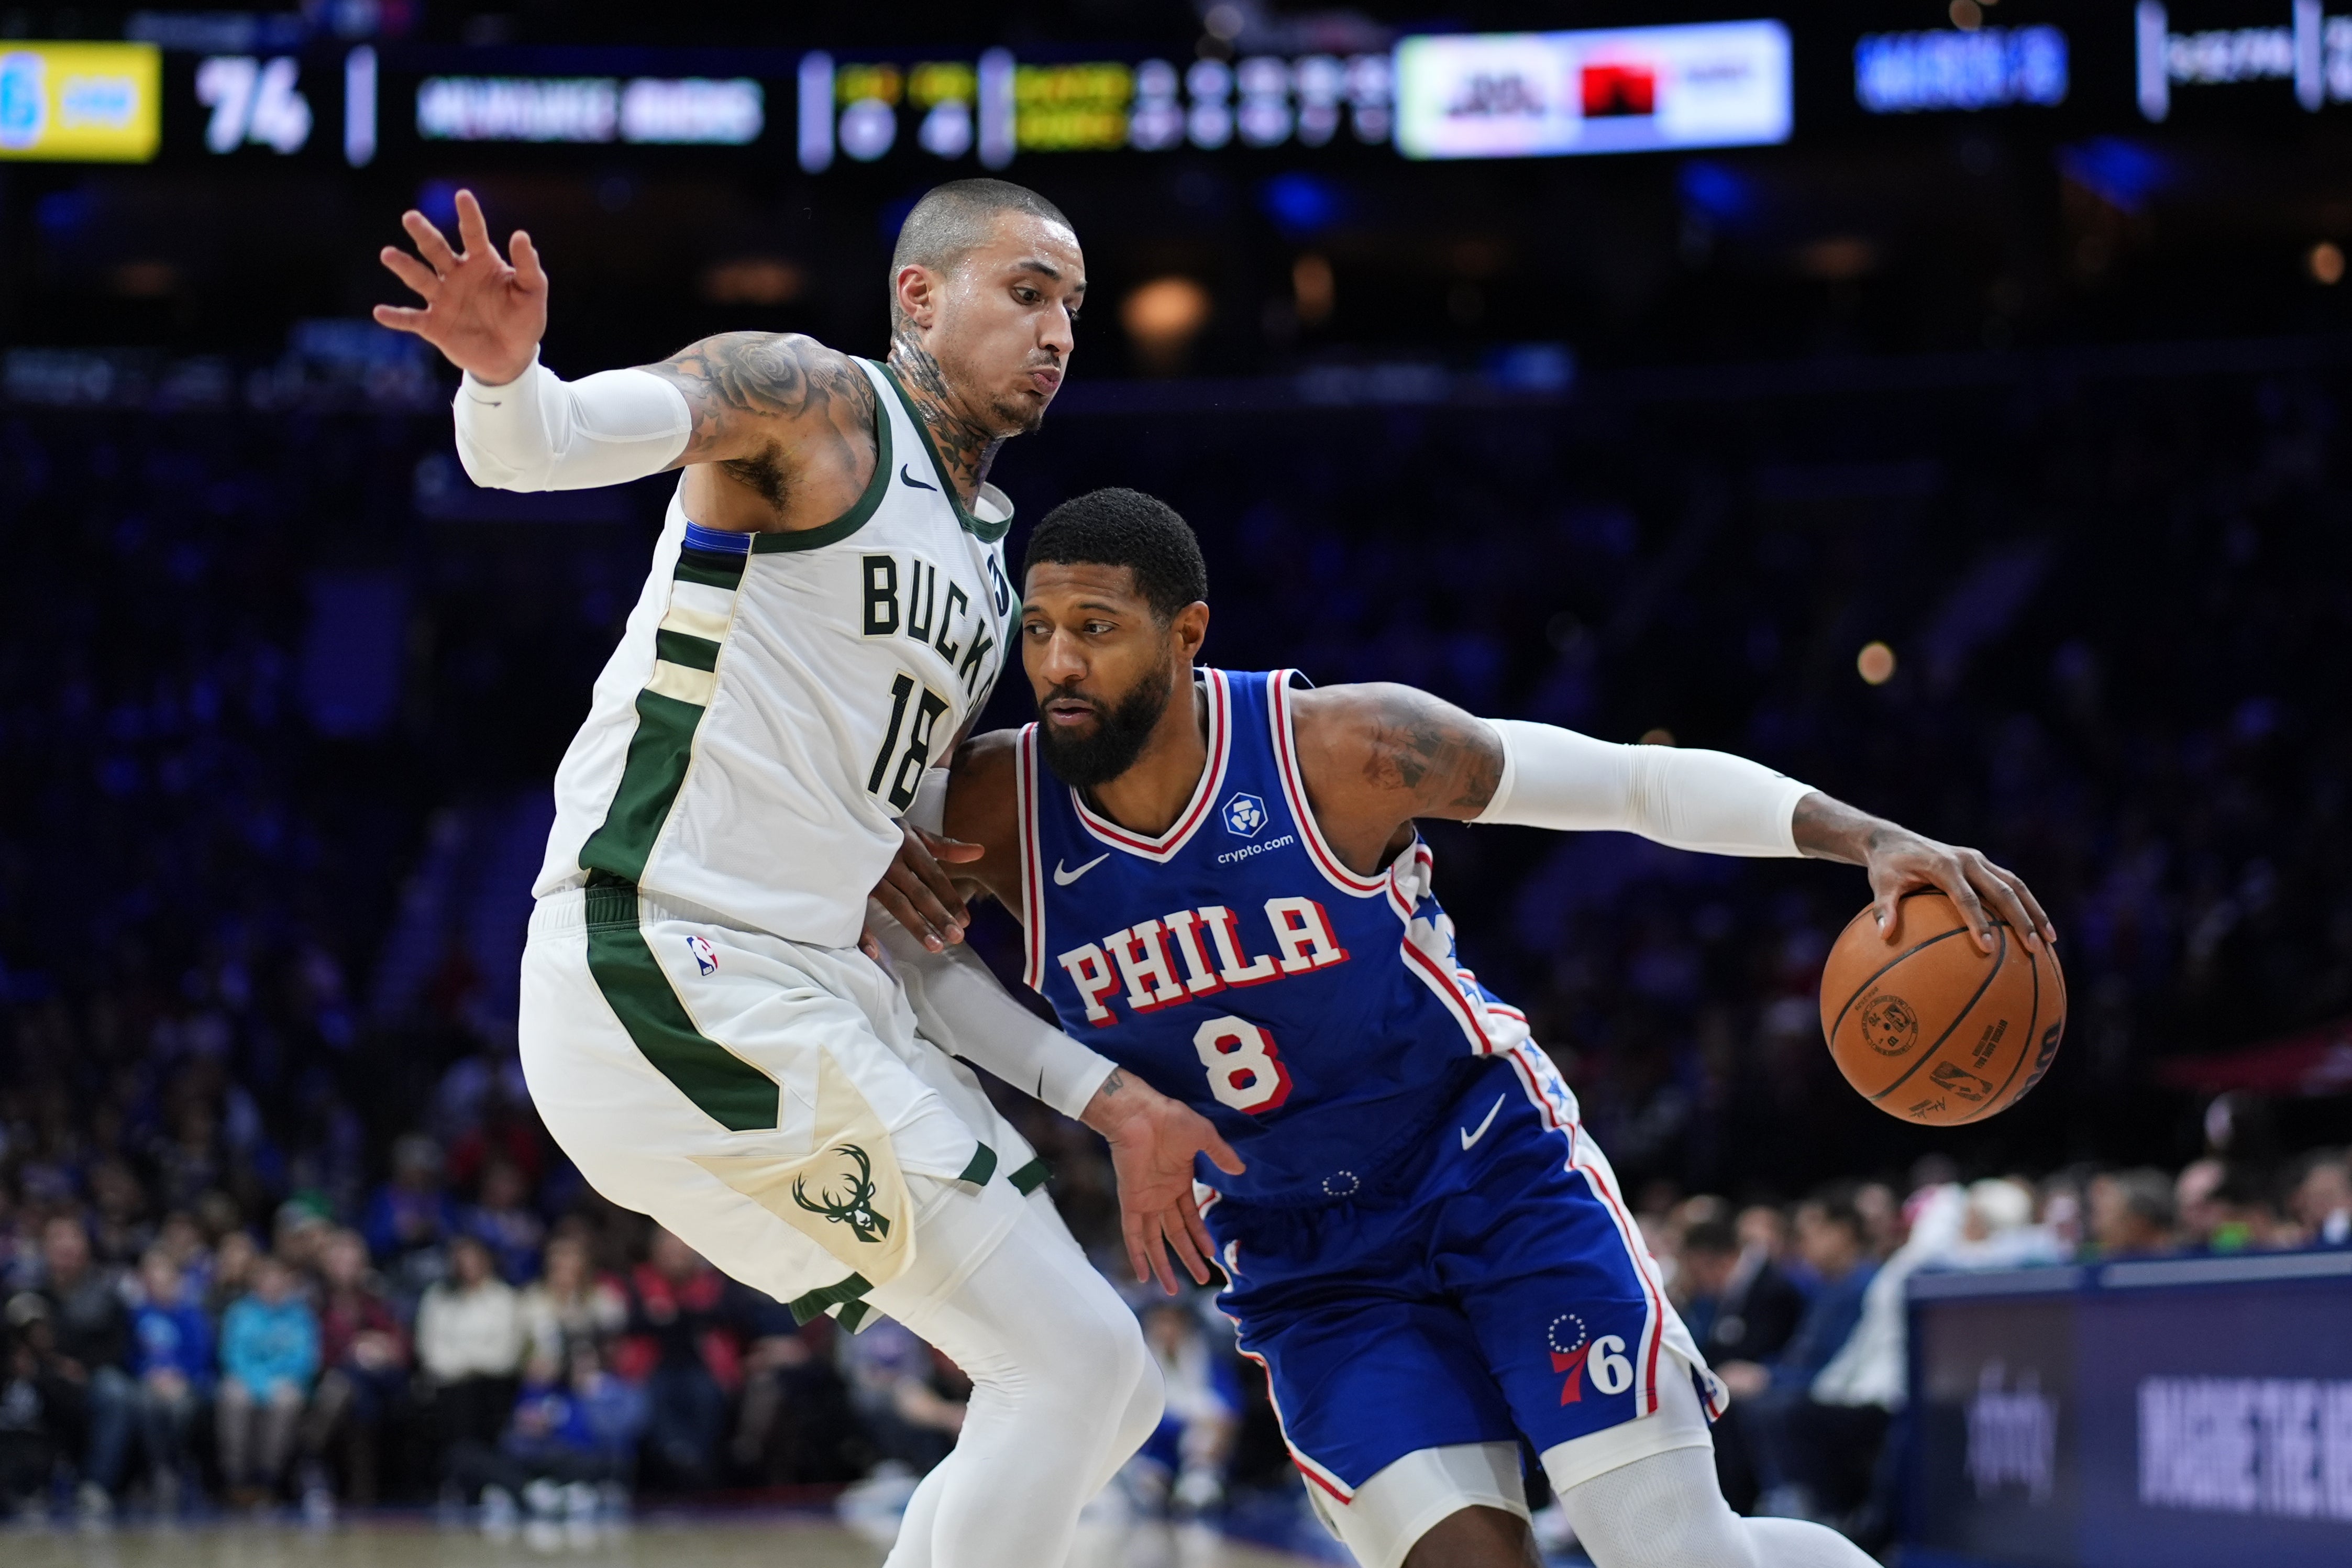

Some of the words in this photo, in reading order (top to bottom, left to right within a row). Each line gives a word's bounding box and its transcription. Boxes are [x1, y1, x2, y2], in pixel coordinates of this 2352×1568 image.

[866, 669, 949, 815] 18
[1218, 834, 1294, 864] crypto.com
[1057, 896, 1350, 1028] PHILA
[1193, 1015, 1293, 1115] 8
[1549, 1334, 1634, 1407] 76
